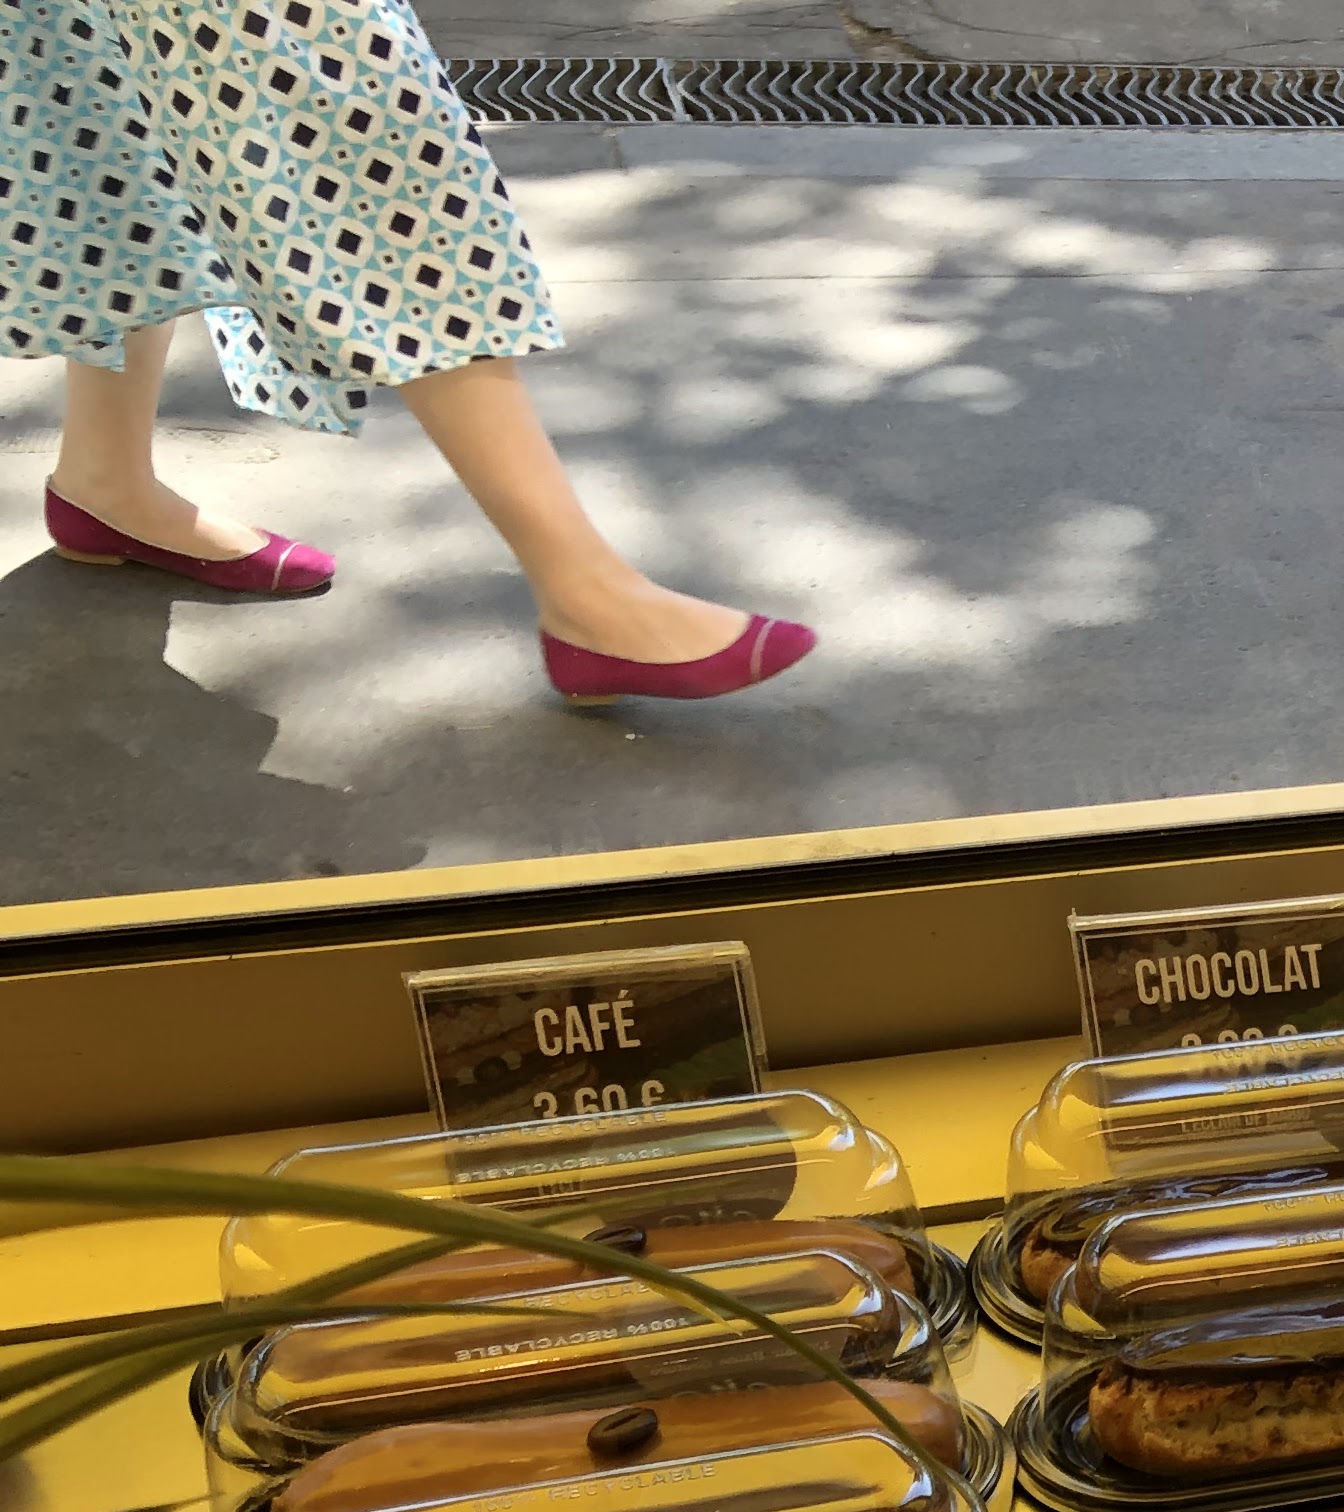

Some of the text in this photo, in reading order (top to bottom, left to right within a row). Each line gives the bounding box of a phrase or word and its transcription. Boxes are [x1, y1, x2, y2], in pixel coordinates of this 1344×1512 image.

[1134, 943, 1323, 1006] CHOCOLAT
[534, 990, 641, 1057] CAFÉ
[456, 1328, 618, 1360] RECYCLABLE
